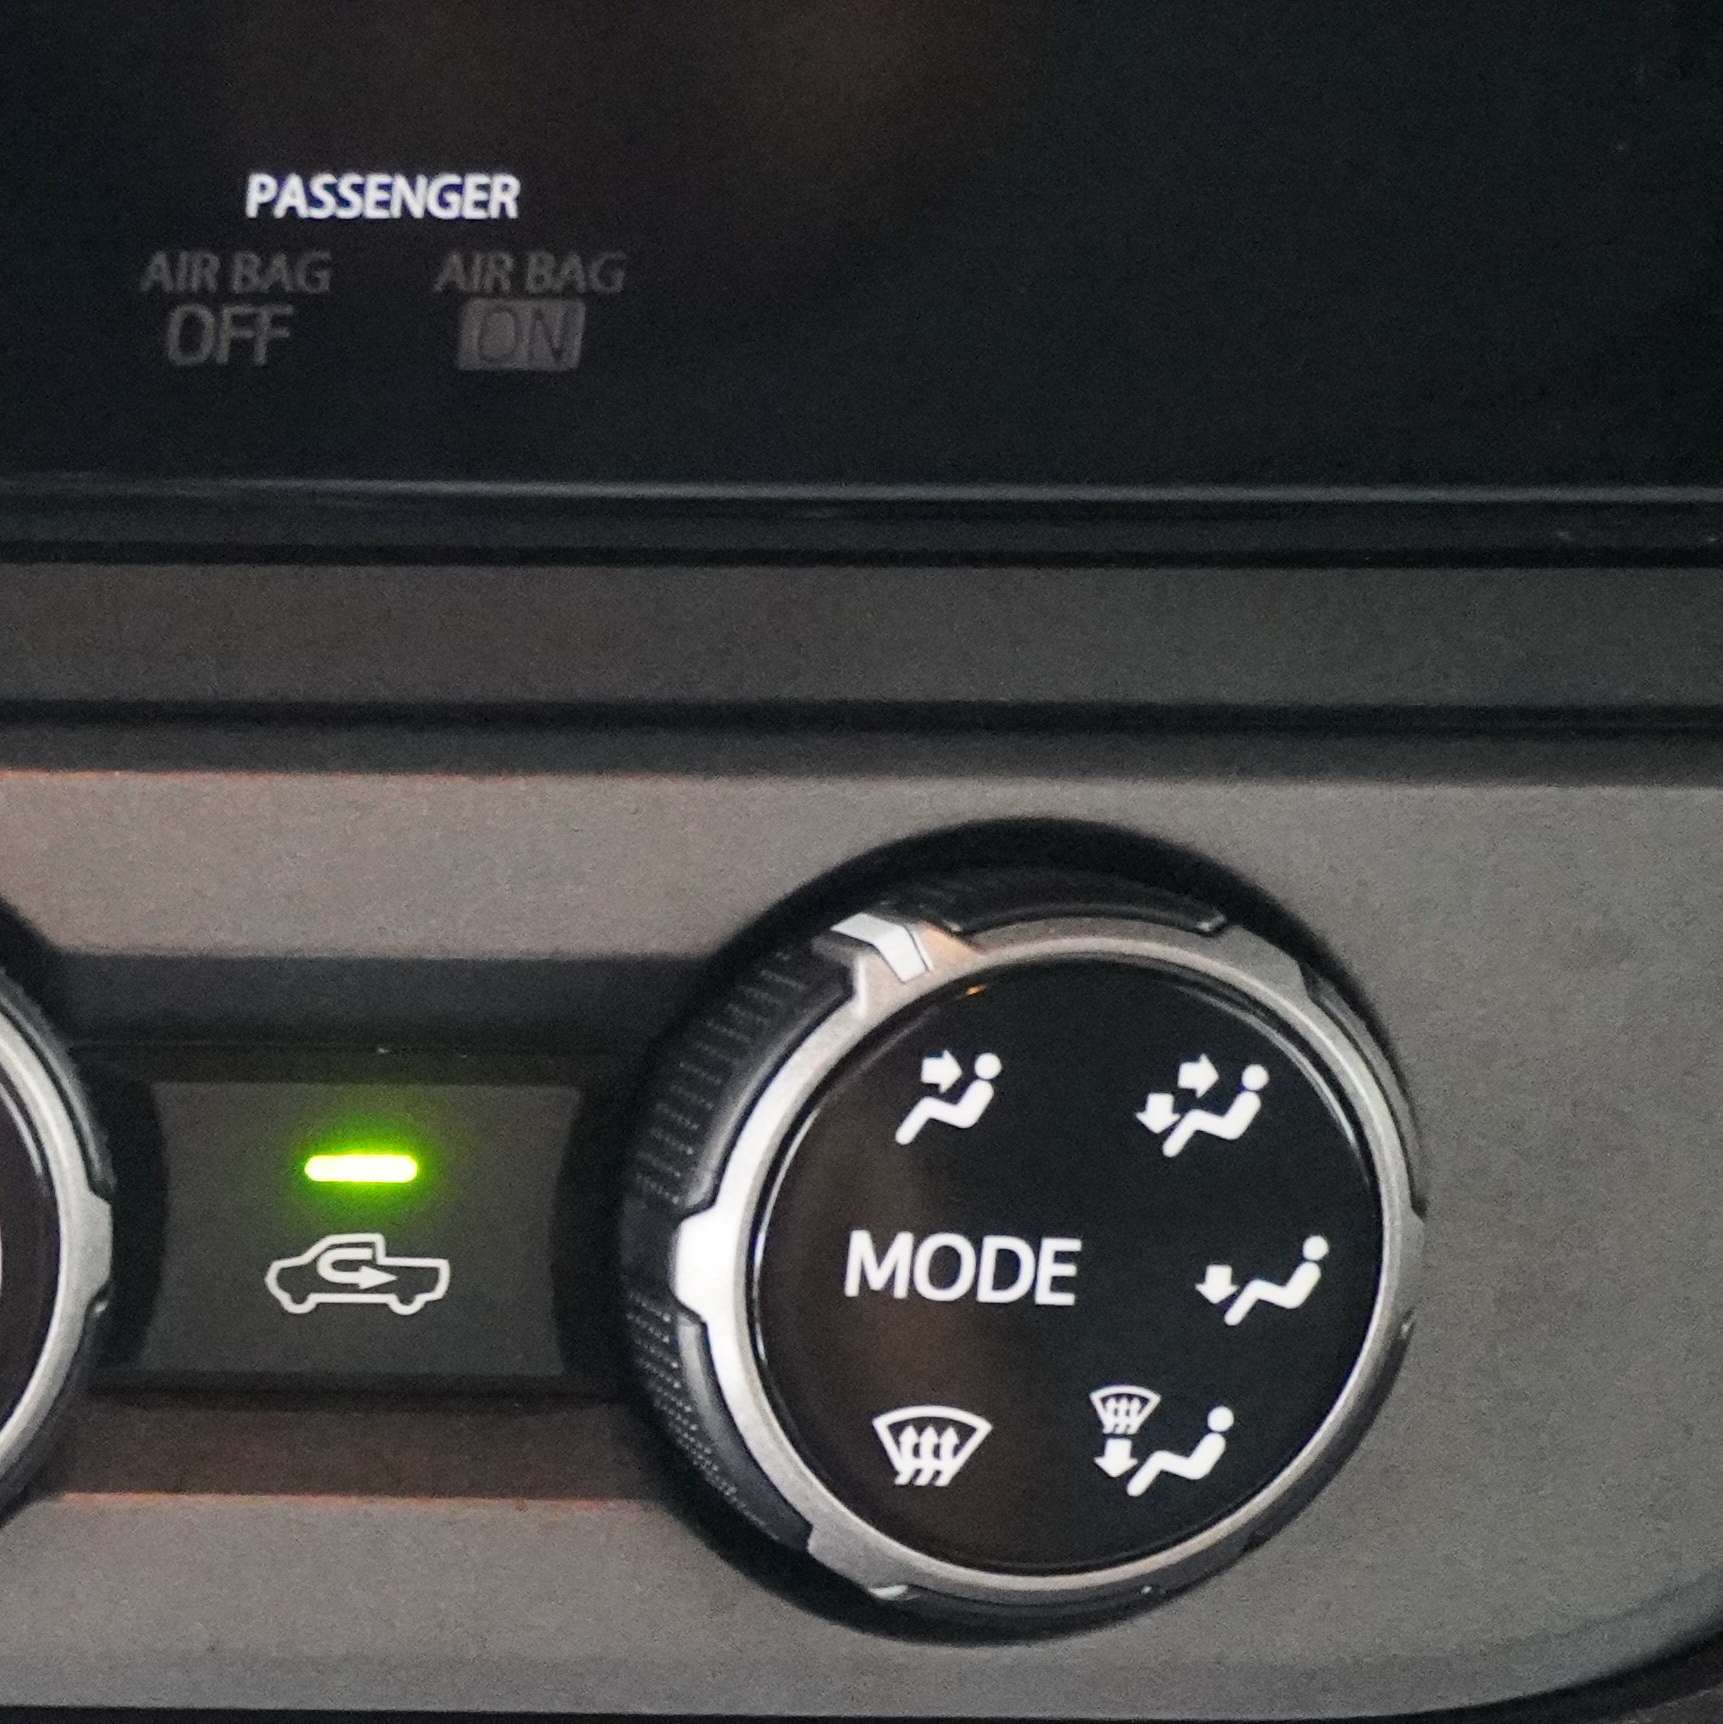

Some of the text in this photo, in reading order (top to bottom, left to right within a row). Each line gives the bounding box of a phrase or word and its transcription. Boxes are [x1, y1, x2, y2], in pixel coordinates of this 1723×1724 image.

[245, 172, 521, 219] PASSENGER
[140, 251, 333, 294] AIR BAG
[434, 251, 626, 294] AIR BAG
[165, 303, 295, 367] OFF
[475, 302, 574, 365] ON
[844, 1229, 1083, 1306] MODE
